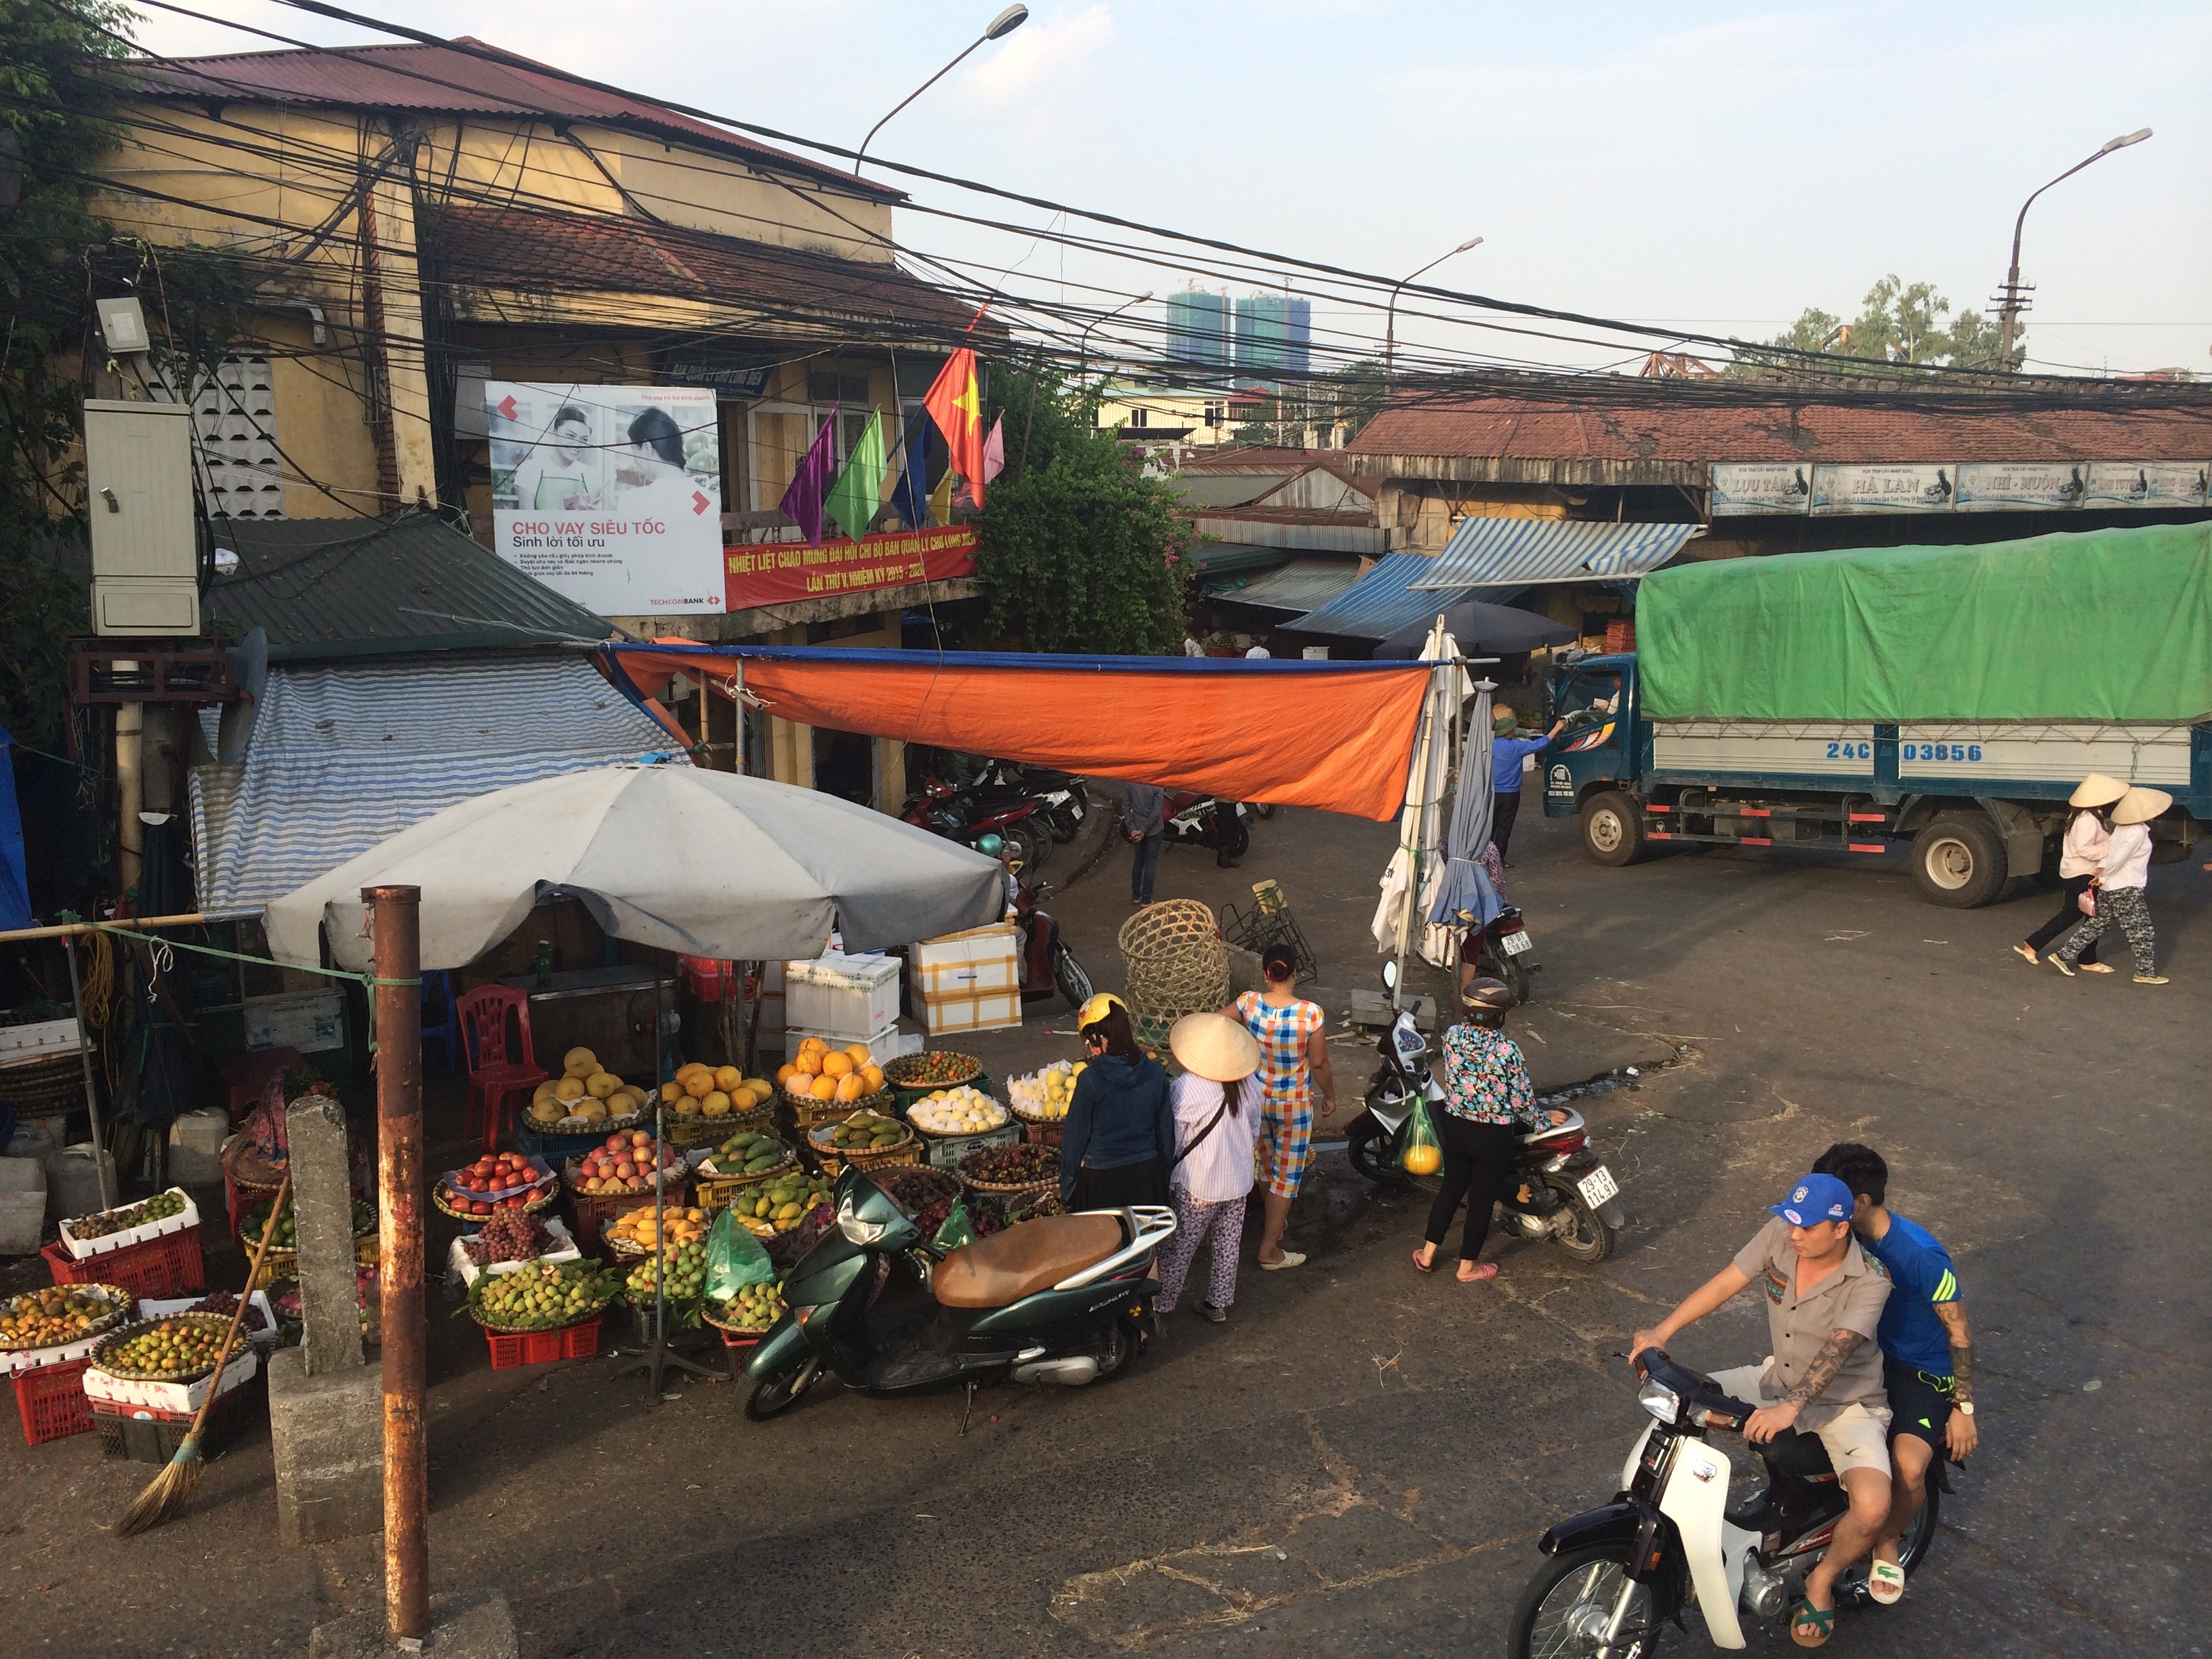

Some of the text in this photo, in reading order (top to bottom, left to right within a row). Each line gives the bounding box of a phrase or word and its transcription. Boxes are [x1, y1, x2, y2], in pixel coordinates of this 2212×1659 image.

[1852, 476, 1920, 494] HÀ LAN
[512, 516, 666, 535] CHO VAY SIÊU TỐC
[512, 535, 605, 548] Sinh lời tối ưu
[729, 552, 756, 576] NHIỆT
[758, 549, 776, 573] LIỆT
[778, 547, 801, 569] CHÀO
[830, 546, 843, 566] ĐẠI
[844, 541, 857, 564] HỘI
[859, 542, 872, 559] CHI
[873, 539, 883, 560] BỘ
[884, 540, 900, 556] BAN
[901, 533, 920, 556] QUẢN
[921, 533, 929, 552] LÝ
[930, 533, 945, 553] CHỢ
[848, 567, 875, 589] NHIỆM
[875, 564, 886, 583] KỲ
[887, 565, 904, 582] 2015
[1826, 742, 1982, 762] 24C 03856
[1588, 1181, 1616, 1207] 114.91
